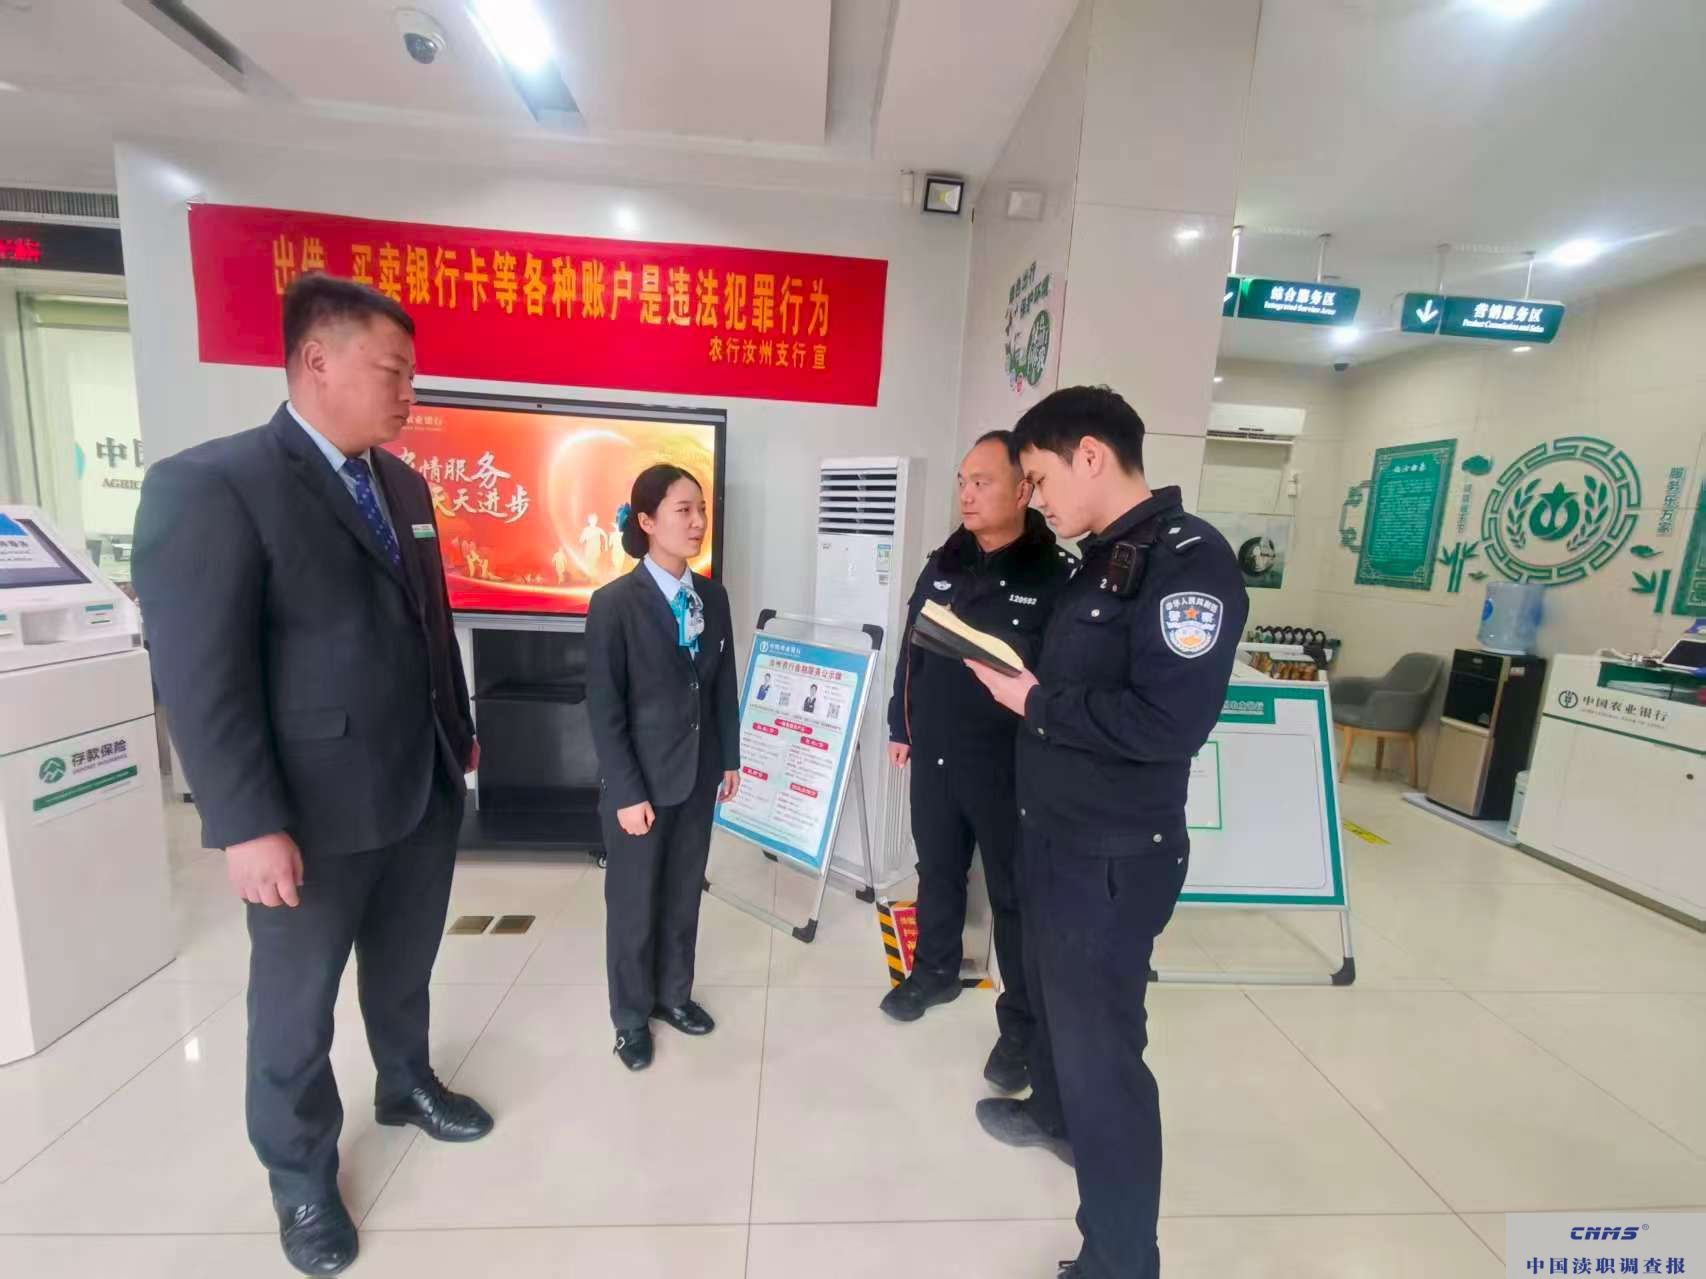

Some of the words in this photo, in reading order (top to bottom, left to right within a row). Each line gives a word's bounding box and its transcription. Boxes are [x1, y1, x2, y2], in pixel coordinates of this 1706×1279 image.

[1270, 286, 1336, 306] 综合服务区
[1298, 304, 1320, 313] Service
[1474, 302, 1543, 323] 营销服务区
[709, 337, 806, 369] 农行汝州支行
[812, 344, 828, 370] 宣
[1165, 596, 1218, 614] 中华人民共和国
[1582, 695, 1668, 722] 中国农业银行
[72, 739, 127, 768] 存款保险
